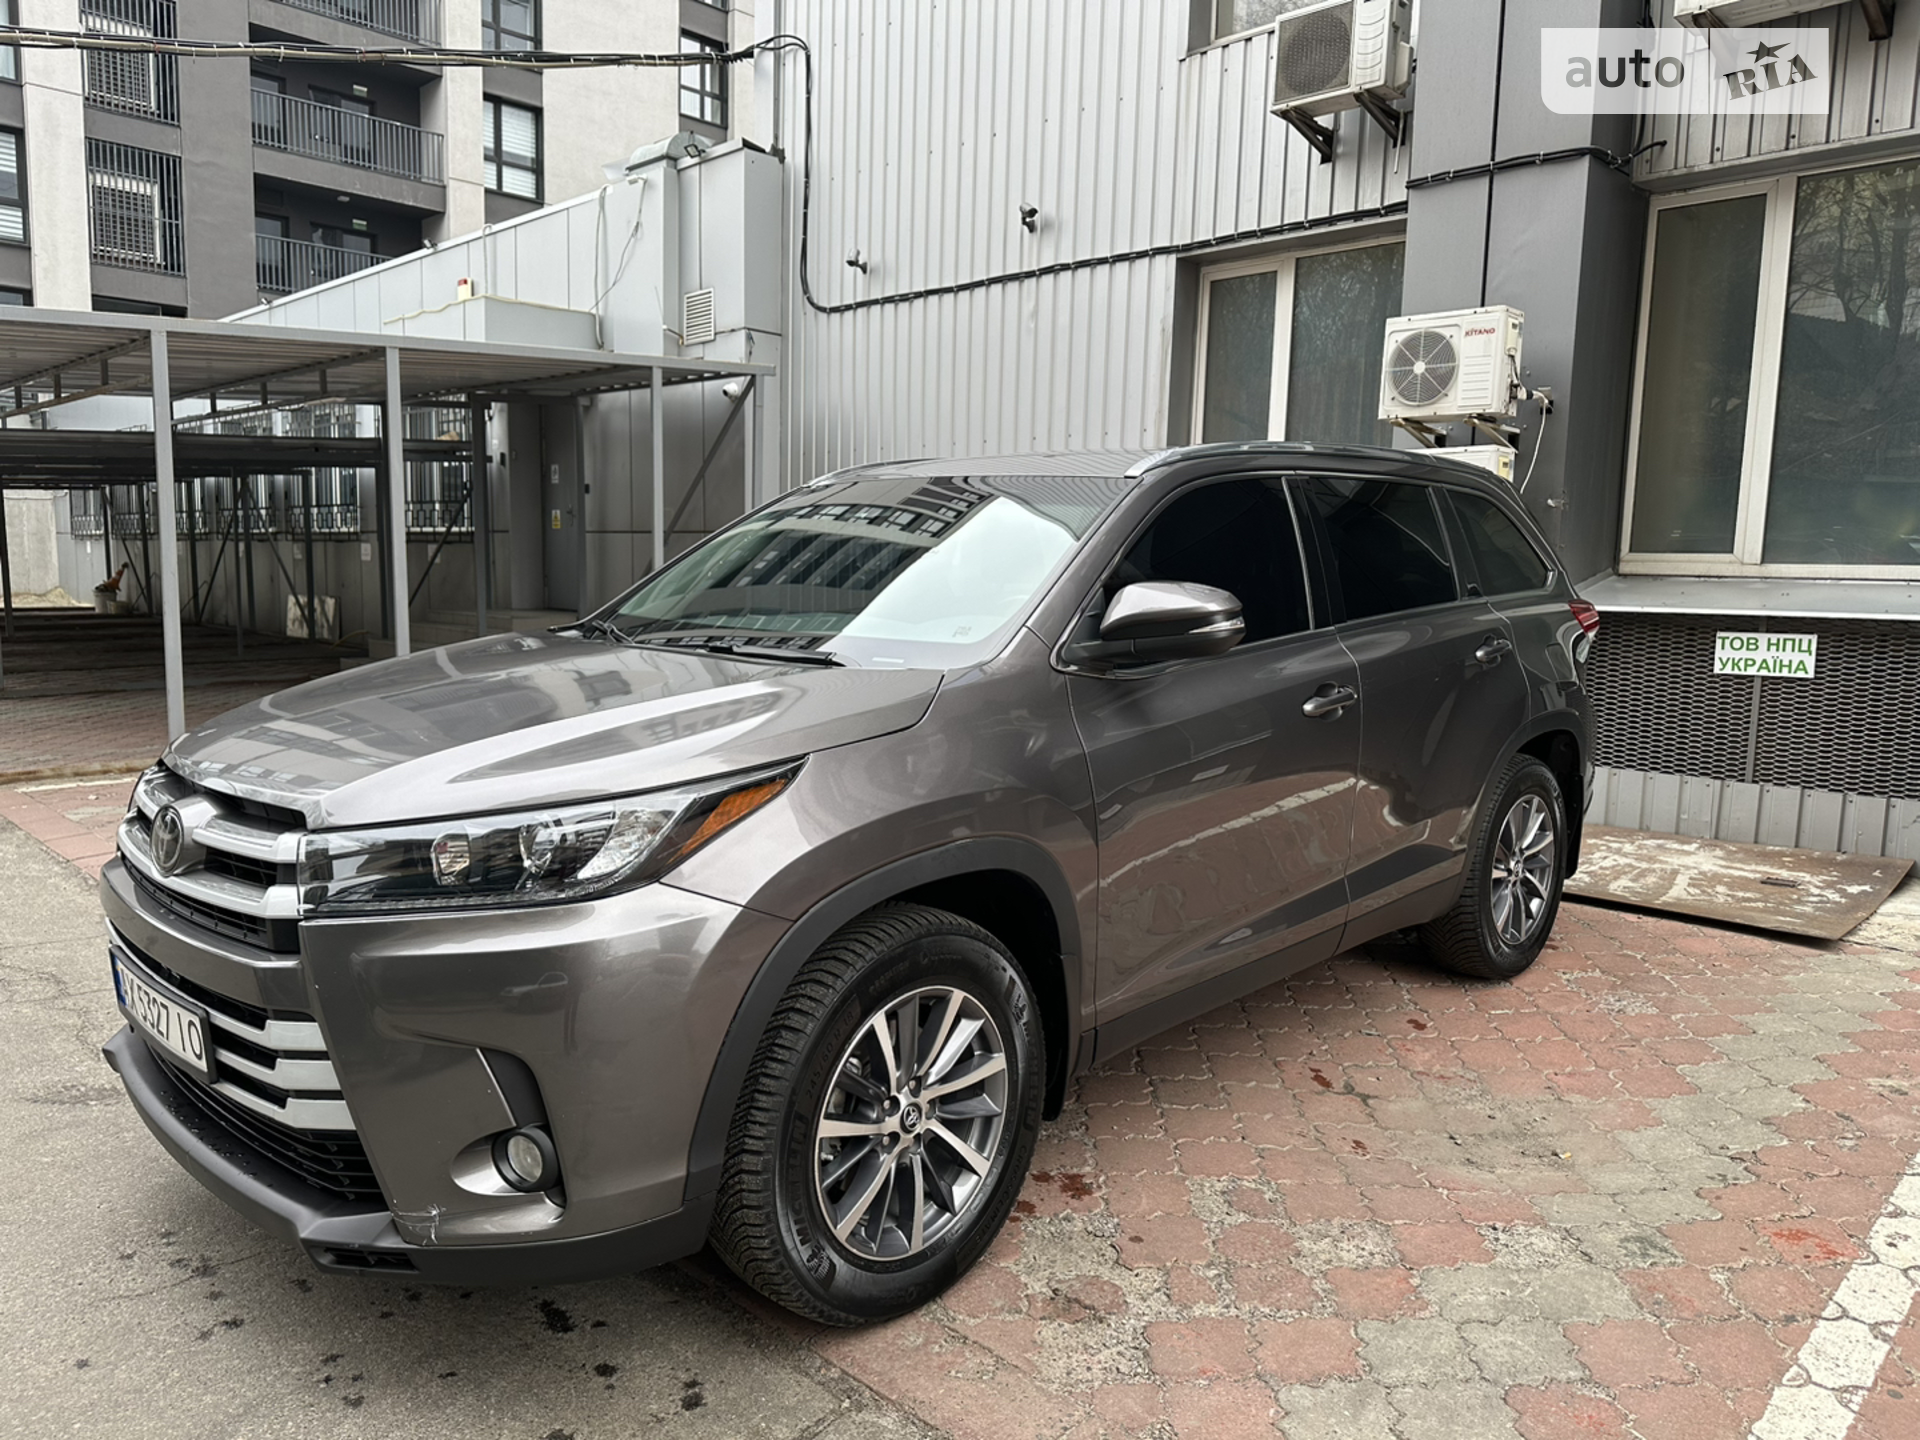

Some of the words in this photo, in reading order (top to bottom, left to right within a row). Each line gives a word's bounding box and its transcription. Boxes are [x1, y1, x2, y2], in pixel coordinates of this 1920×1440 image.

[1464, 327, 1496, 338] KITANO
[1717, 636, 1760, 652] ТОВ
[1766, 637, 1813, 656] НПЦ
[1718, 656, 1810, 675] УКРАЇНА
